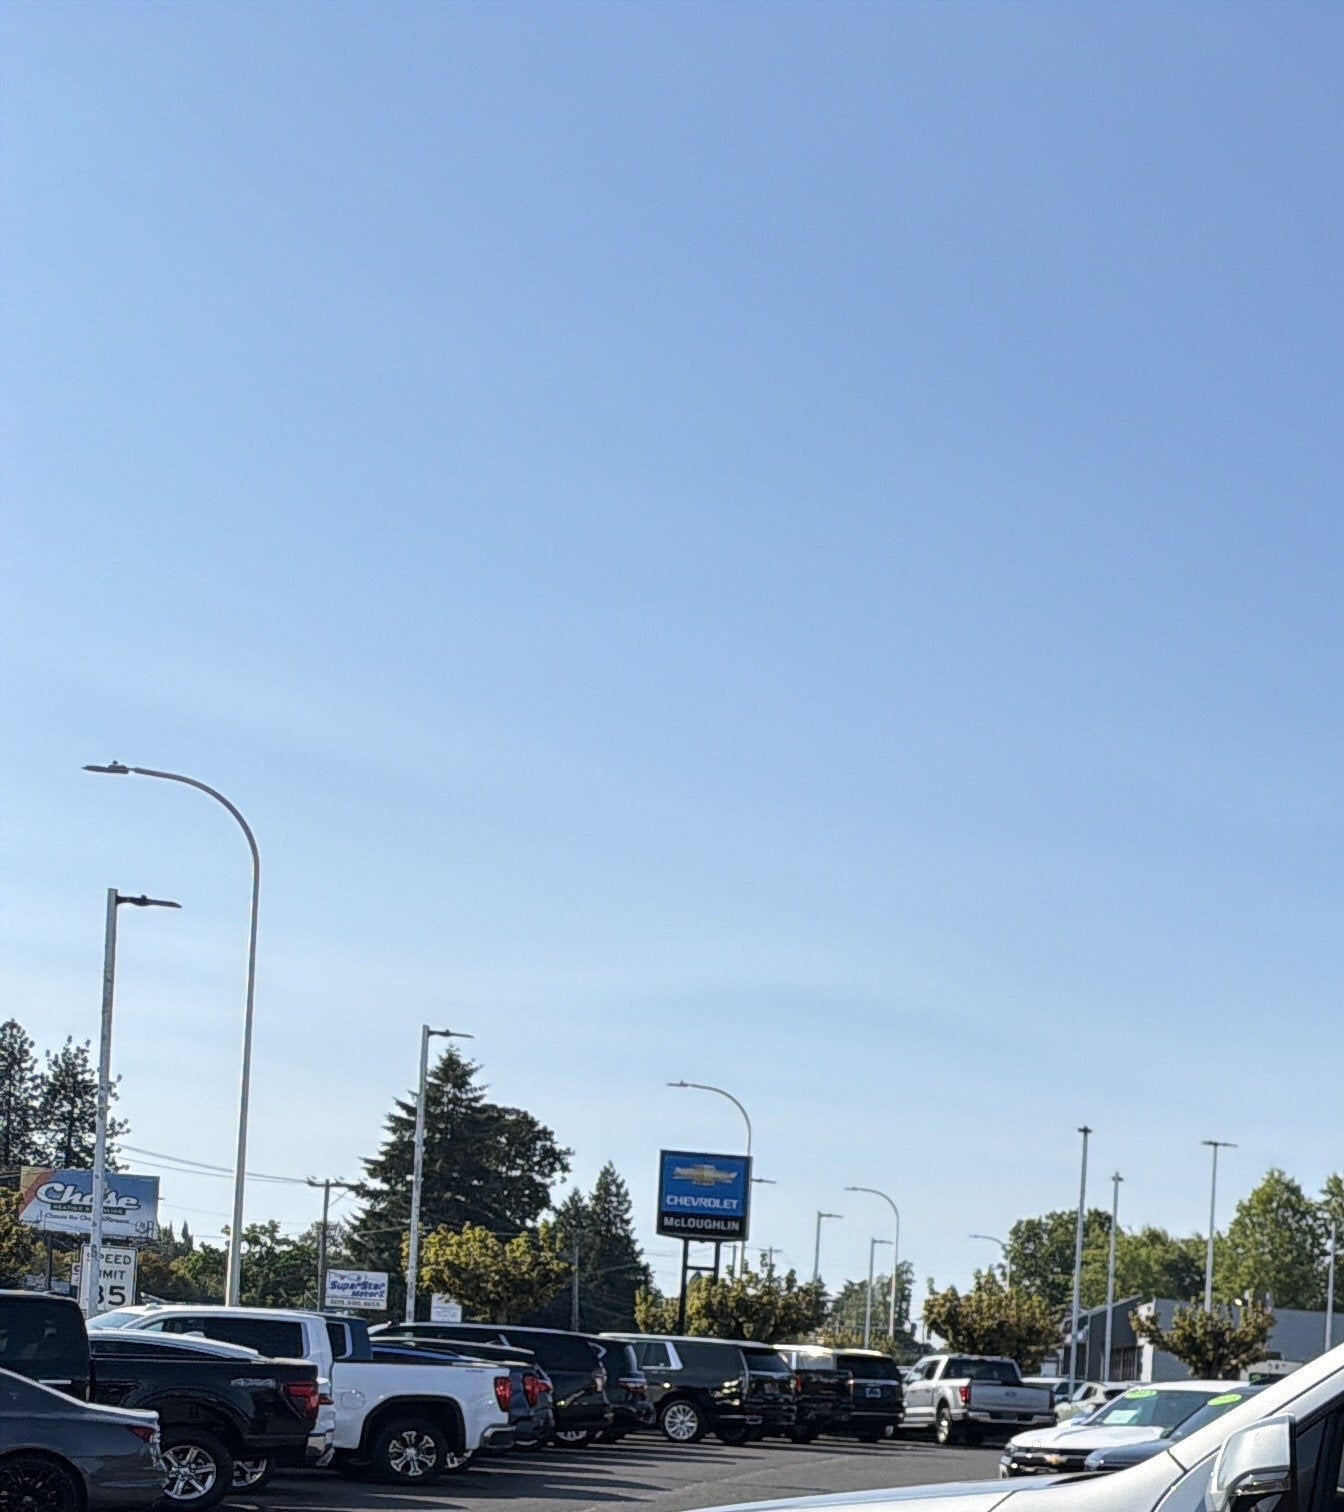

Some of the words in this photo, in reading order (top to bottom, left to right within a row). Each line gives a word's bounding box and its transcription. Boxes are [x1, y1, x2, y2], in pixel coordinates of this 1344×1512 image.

[666, 1195, 740, 1210] CHEVROLET
[663, 1216, 740, 1231] McLOUGHLIN
[98, 1268, 126, 1280] IMIT
